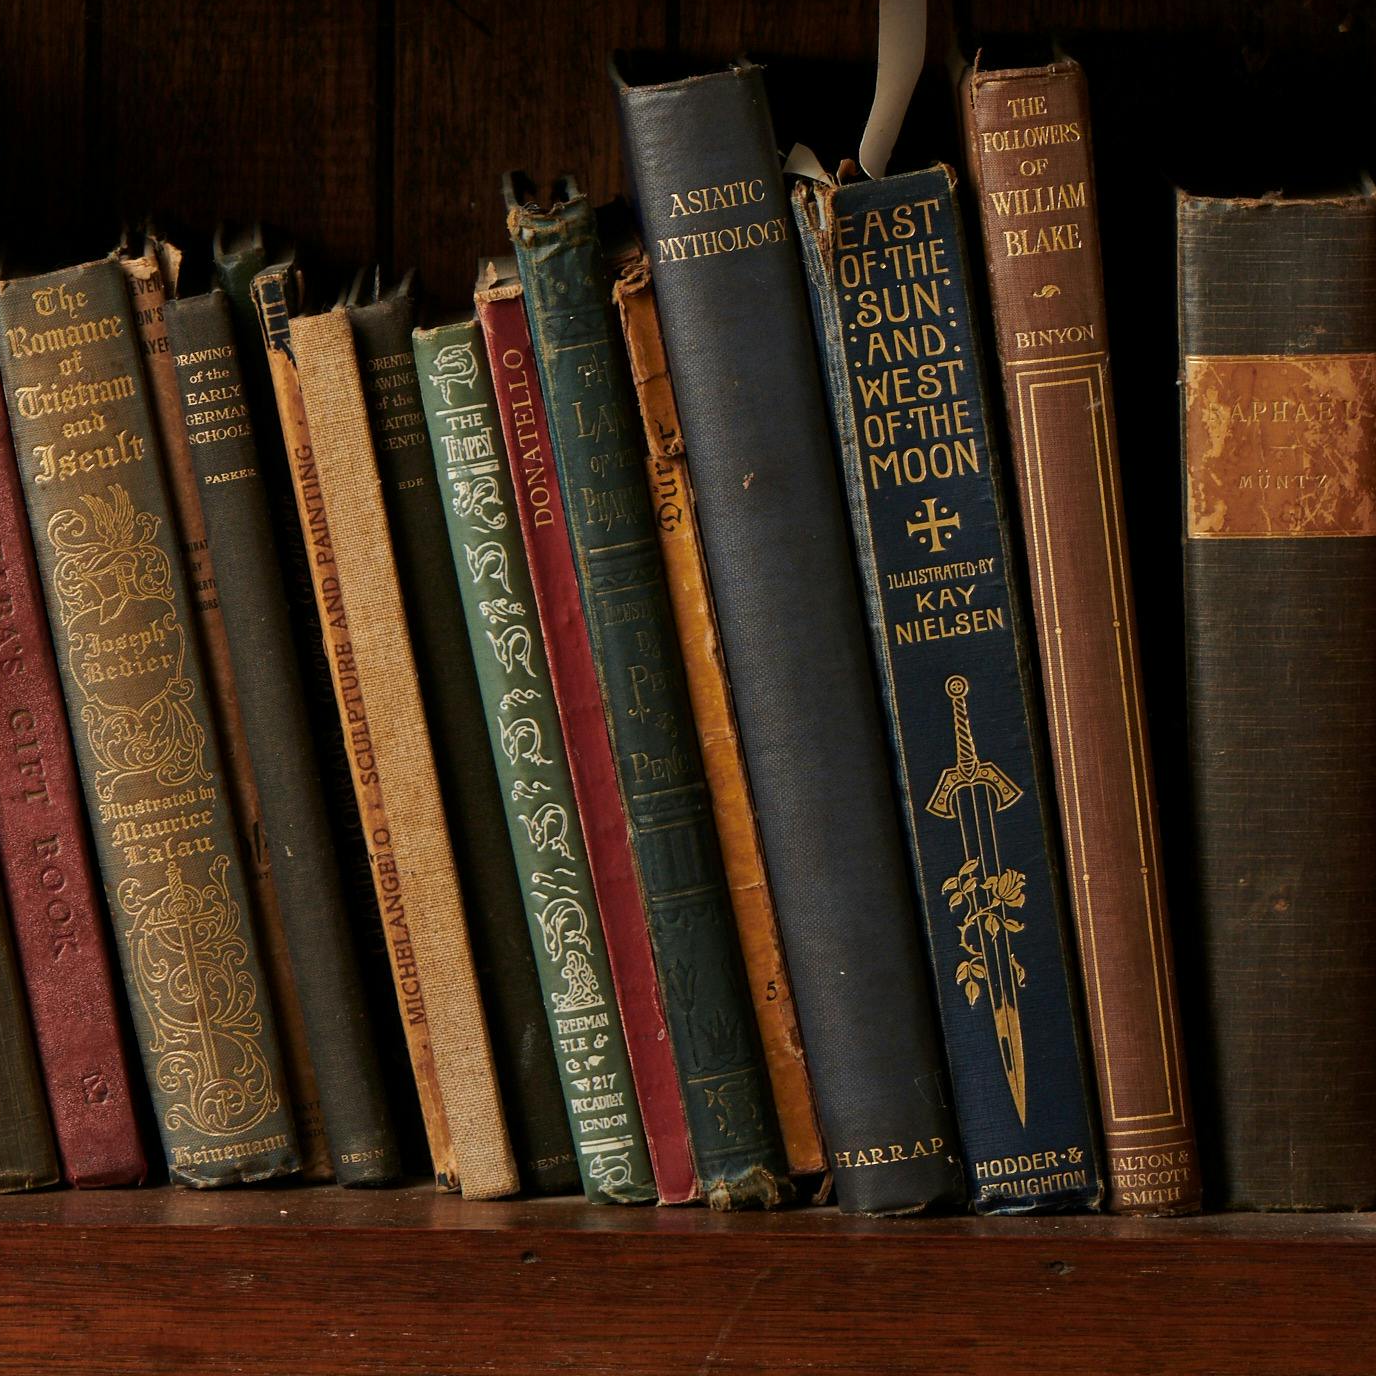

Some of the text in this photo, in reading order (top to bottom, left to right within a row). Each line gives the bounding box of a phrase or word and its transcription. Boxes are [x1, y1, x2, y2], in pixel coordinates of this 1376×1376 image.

[981, 123, 1080, 153] FOLLOWERS
[669, 179, 765, 218] ASIATIC
[990, 182, 1086, 216] WILLIAM
[658, 216, 790, 264] MYTHOLOGY
[833, 199, 941, 249] EAST
[1005, 224, 1082, 257] BLAKE
[33, 283, 87, 318] The
[855, 281, 941, 324] SUN
[5, 315, 122, 359] Romance
[867, 324, 947, 364] AND
[1014, 324, 1095, 349] BINYON
[60, 354, 82, 377] of
[15, 373, 136, 420] Tristram
[186, 385, 241, 406] EARLY
[856, 360, 965, 409] WEST
[62, 415, 106, 439] and
[446, 412, 483, 431] THE
[513, 348, 554, 529] DONATELLO
[440, 427, 494, 462] TEMPEST
[868, 439, 979, 490] MOON
[295, 444, 334, 564] PAINTING
[915, 586, 976, 614] KAY
[84, 626, 166, 663] Joseph
[895, 608, 1004, 648] NIELSEN
[333, 639, 380, 787] SCULPTURE
[112, 808, 213, 848] Maurice
[557, 1014, 609, 1035] FREEMAN
[592, 1073, 615, 1090] 217
[579, 1112, 627, 1131] LONDON
[171, 1134, 288, 1168] Heinemann
[340, 1149, 384, 1163] BENN
[835, 1137, 944, 1169] HARRAP
[1122, 1188, 1181, 1205] SMITH
